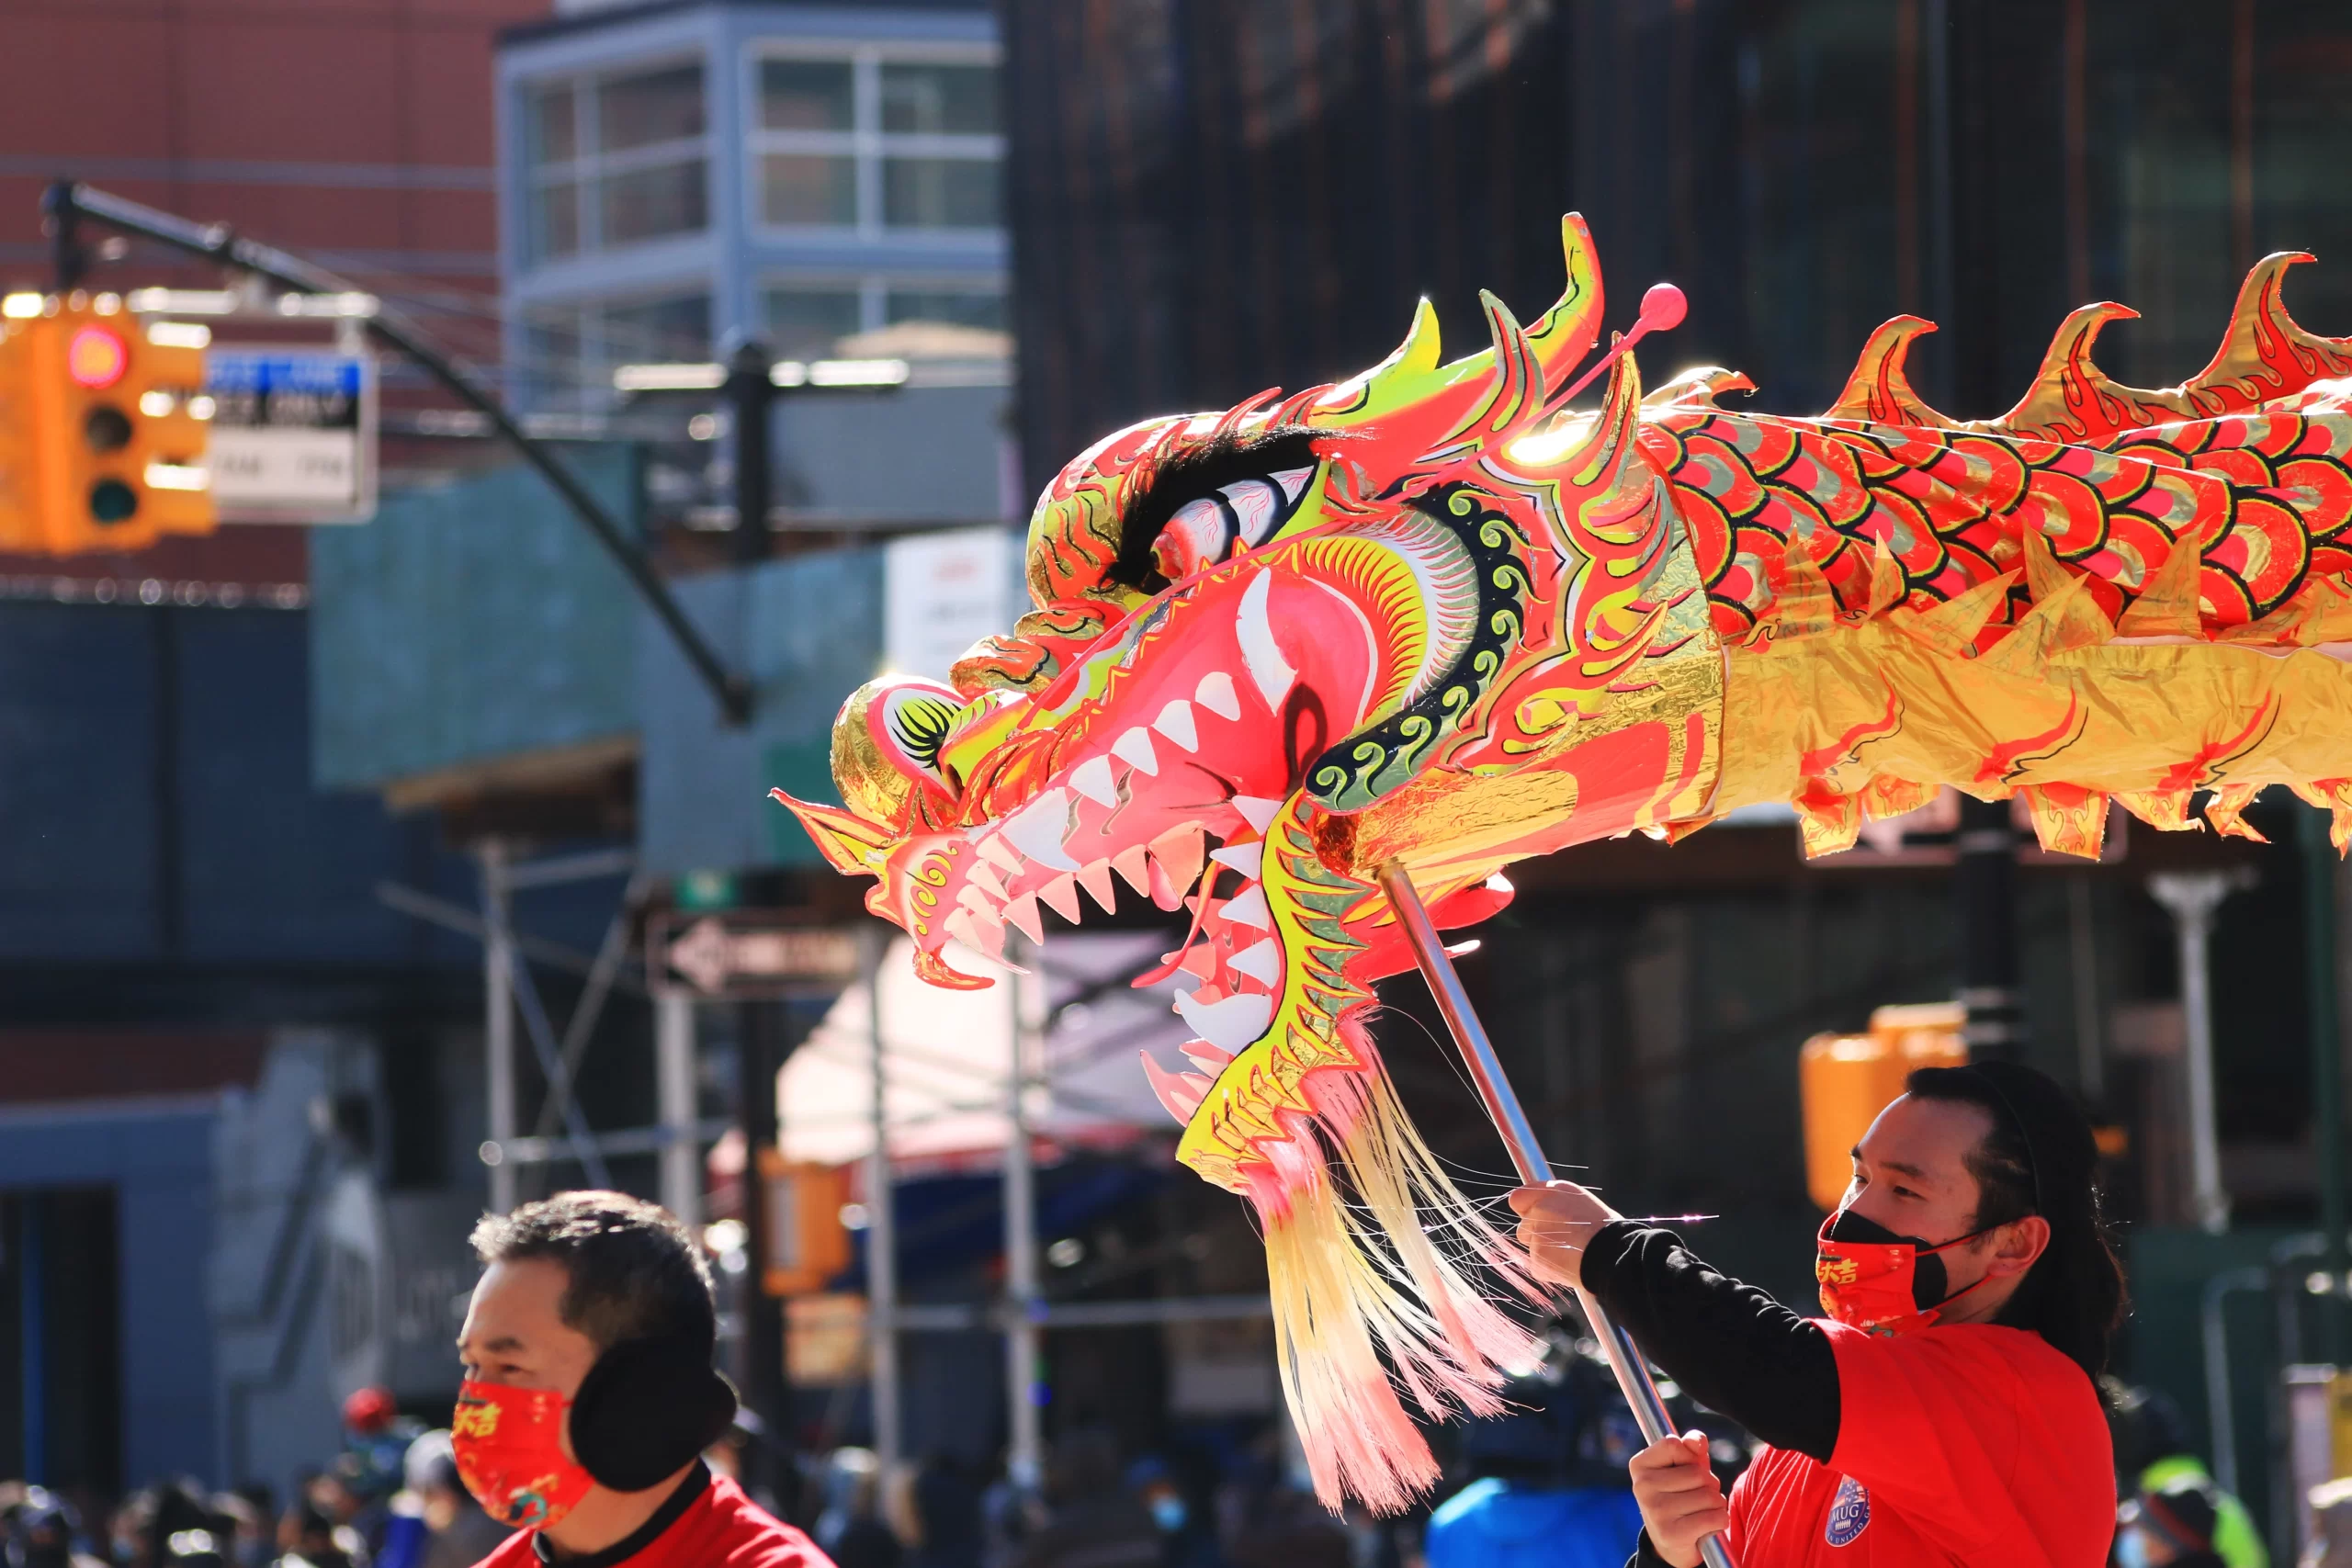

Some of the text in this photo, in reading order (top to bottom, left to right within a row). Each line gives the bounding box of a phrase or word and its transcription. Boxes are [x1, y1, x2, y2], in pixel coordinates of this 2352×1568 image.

[453, 1402, 502, 1438] 大吉
[1832, 1505, 1860, 1524] MUG
[1836, 1522, 1863, 1543] UNITED
